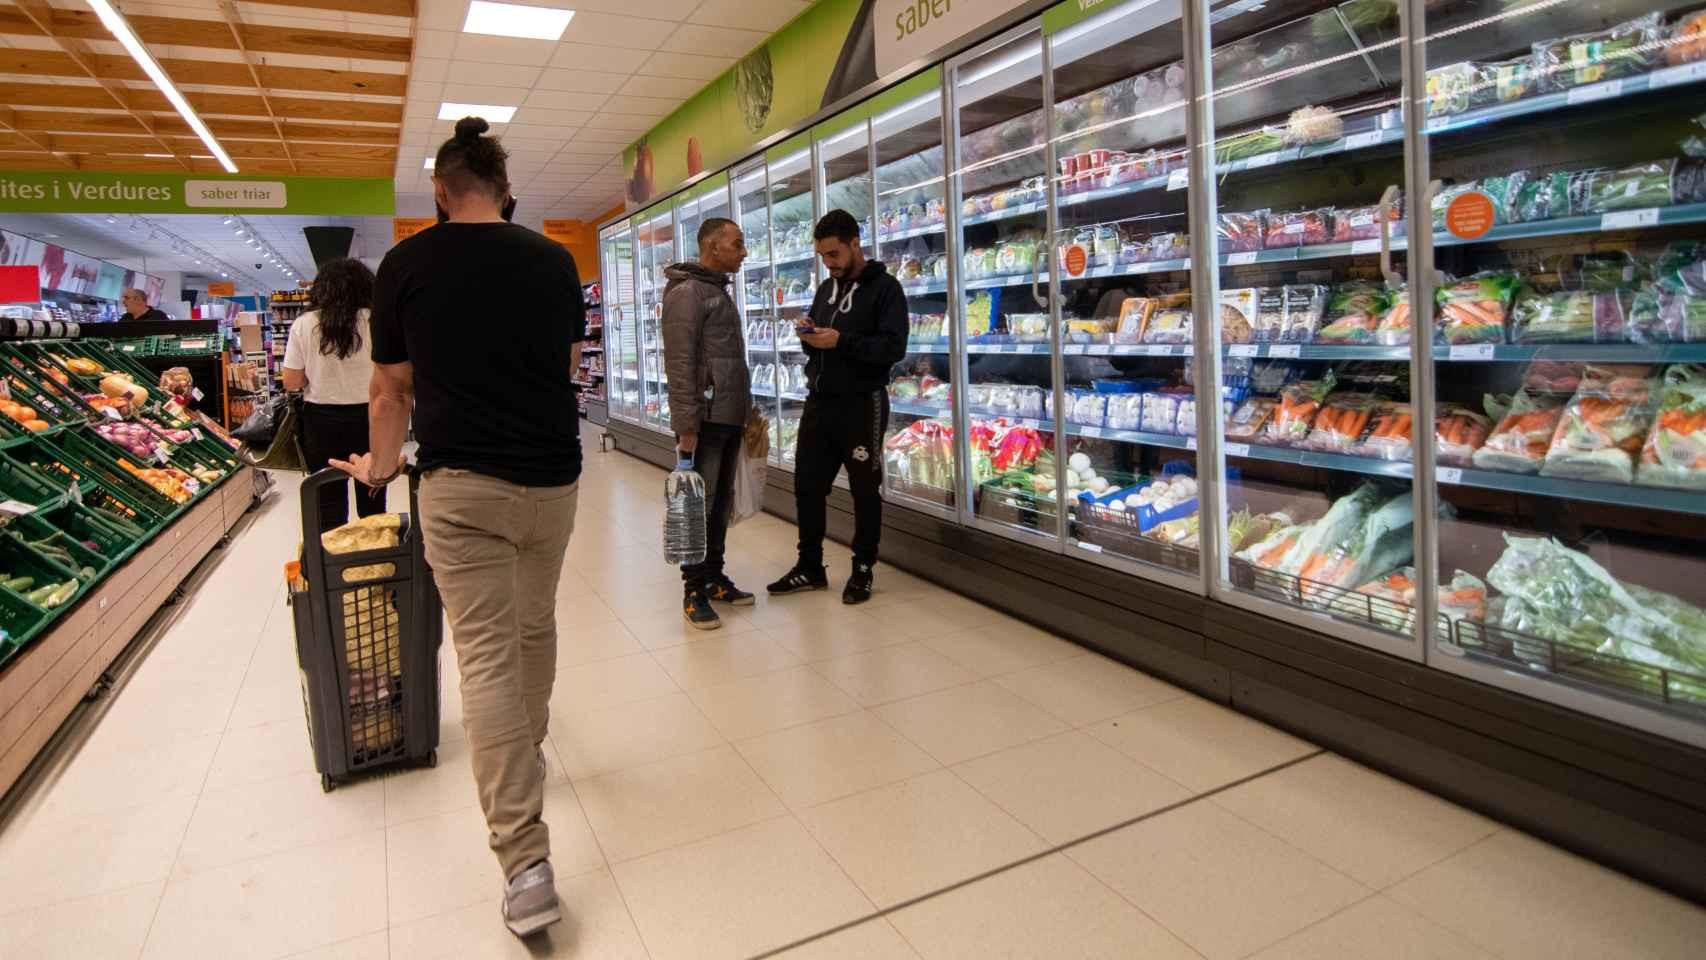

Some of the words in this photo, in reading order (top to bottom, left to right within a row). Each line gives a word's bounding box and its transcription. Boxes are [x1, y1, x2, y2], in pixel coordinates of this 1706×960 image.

[53, 180, 60, 200] i
[67, 180, 172, 201] Verdures
[200, 187, 239, 201] saber
[242, 187, 271, 201] triar
